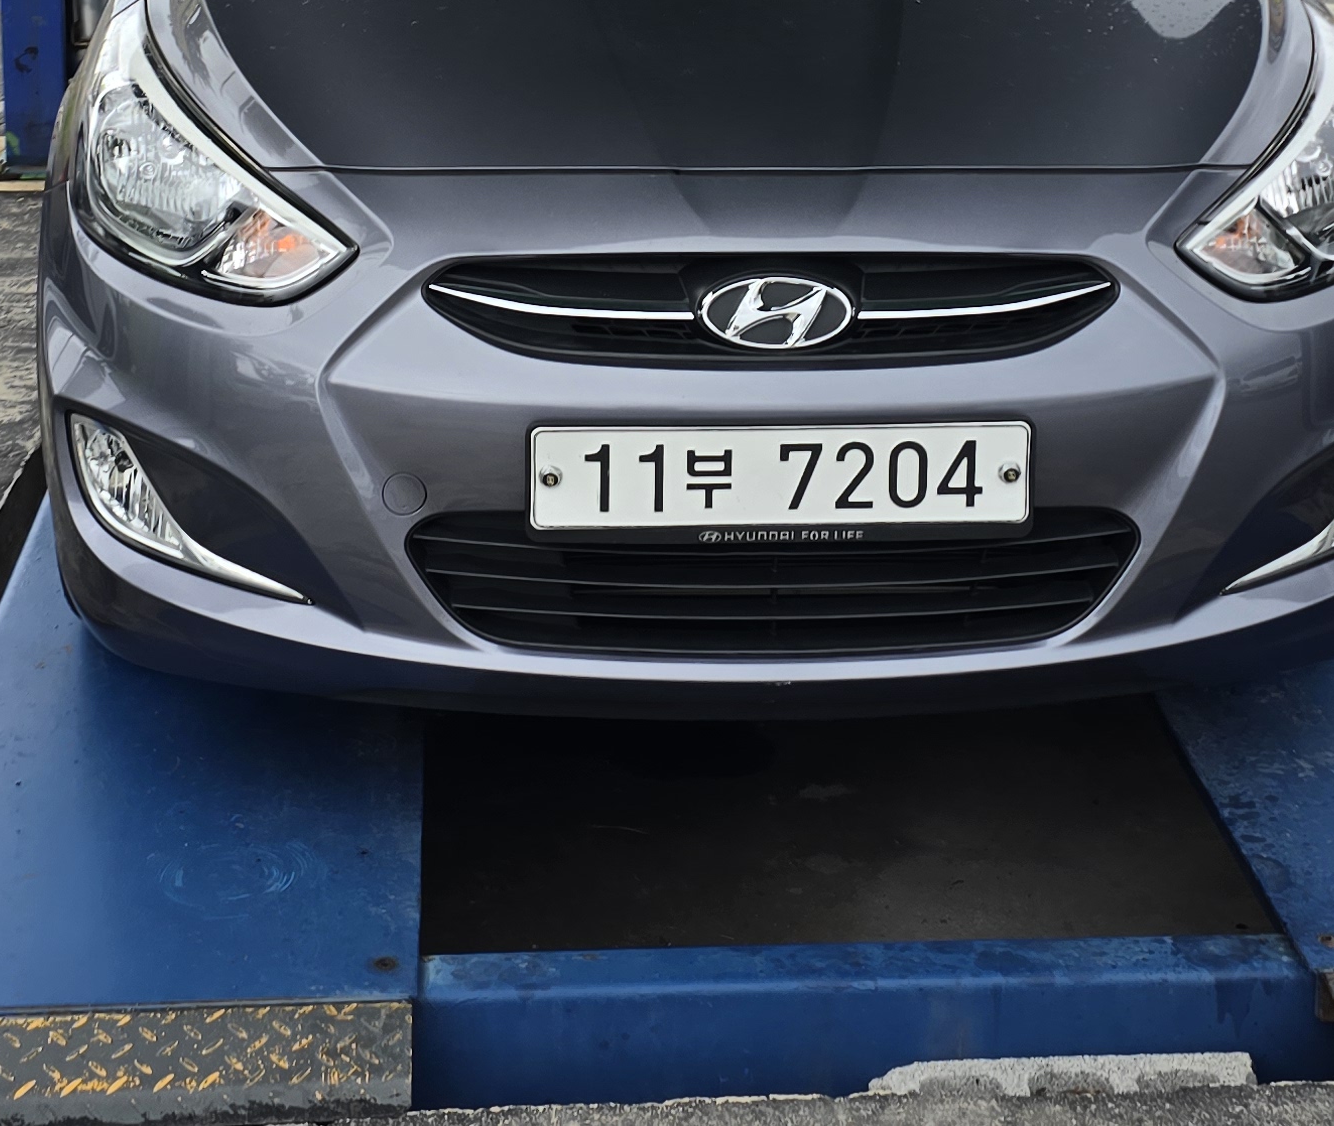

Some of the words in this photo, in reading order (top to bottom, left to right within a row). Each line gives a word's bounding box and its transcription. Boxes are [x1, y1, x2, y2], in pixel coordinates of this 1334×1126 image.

[584, 444, 733, 513] 11부
[779, 440, 983, 510] 7204
[724, 530, 795, 542] HYUNDAI
[801, 530, 829, 542] FOR
[834, 529, 864, 541] LIFE
